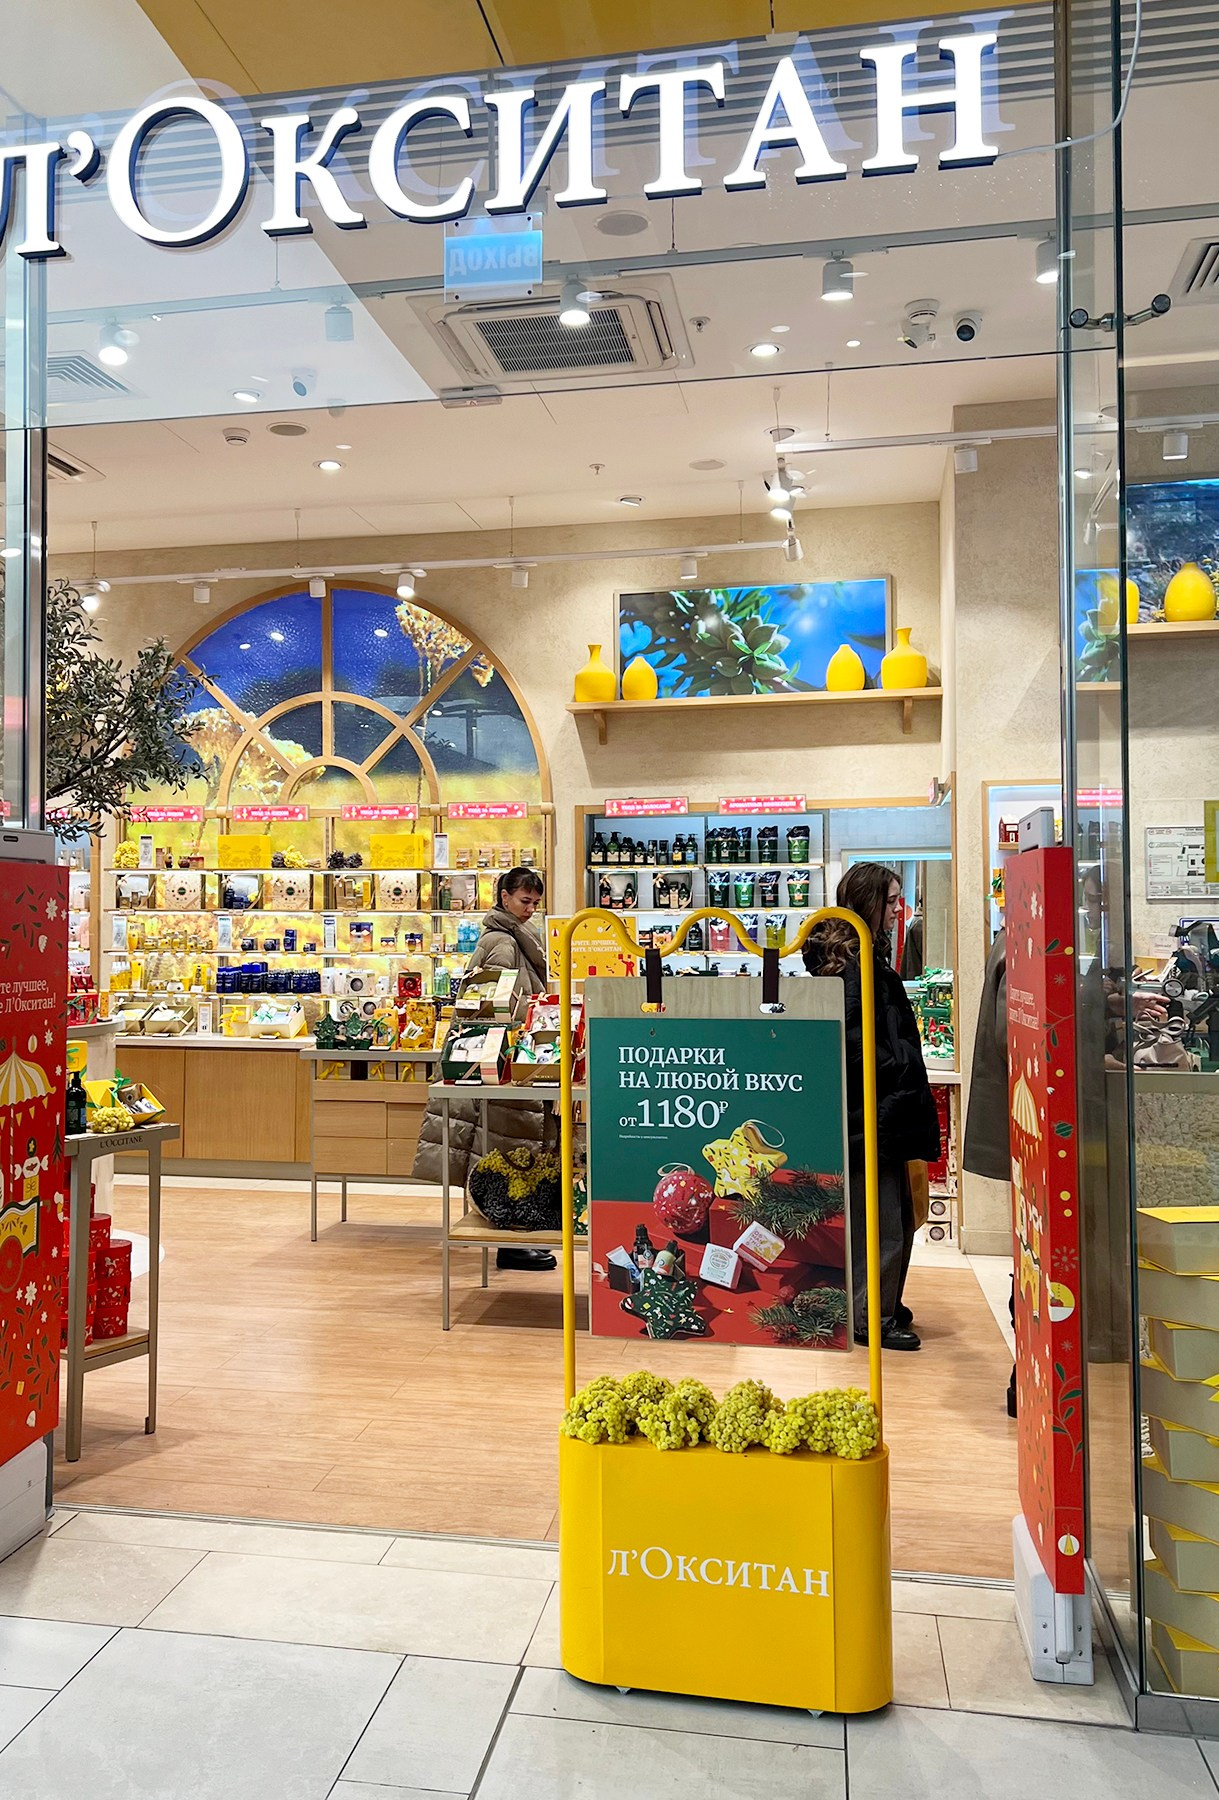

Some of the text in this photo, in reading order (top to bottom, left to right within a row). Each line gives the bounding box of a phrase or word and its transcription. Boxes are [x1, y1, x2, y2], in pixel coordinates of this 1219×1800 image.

[12, 980, 49, 997] лучшее,
[5, 992, 56, 1013] Л'Окситан!
[618, 1046, 725, 1067] ПОДАРКИ
[618, 1068, 803, 1091] НА ЛЮБОЙ ВКУС
[619, 1117, 637, 1127] от
[100, 1135, 144, 1149] L'OCCITANE
